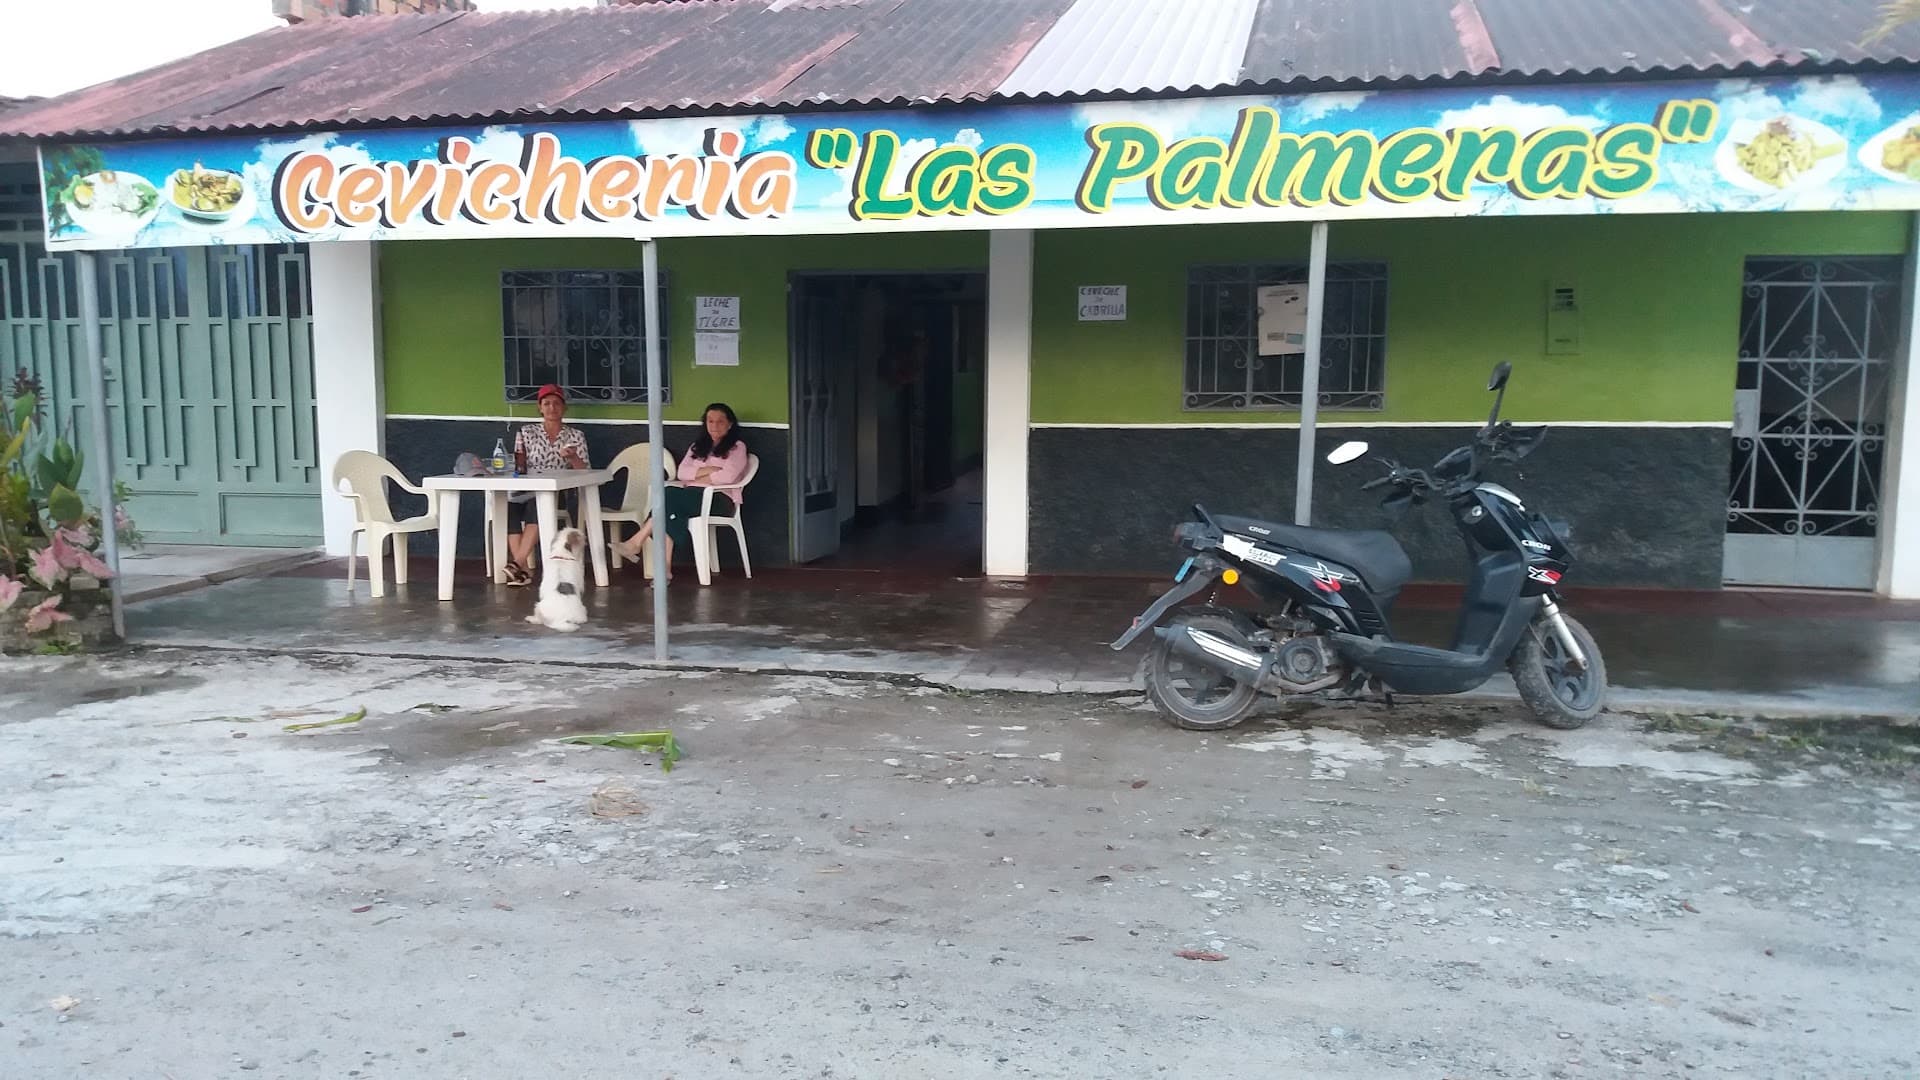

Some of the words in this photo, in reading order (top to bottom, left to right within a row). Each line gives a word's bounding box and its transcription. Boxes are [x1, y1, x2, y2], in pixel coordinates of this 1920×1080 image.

[275, 128, 797, 231] Cevicheria
[808, 127, 1033, 220] "Las
[1077, 102, 1716, 212] Palmeras"
[703, 297, 733, 308] LECHE
[699, 316, 736, 328] TIGRE
